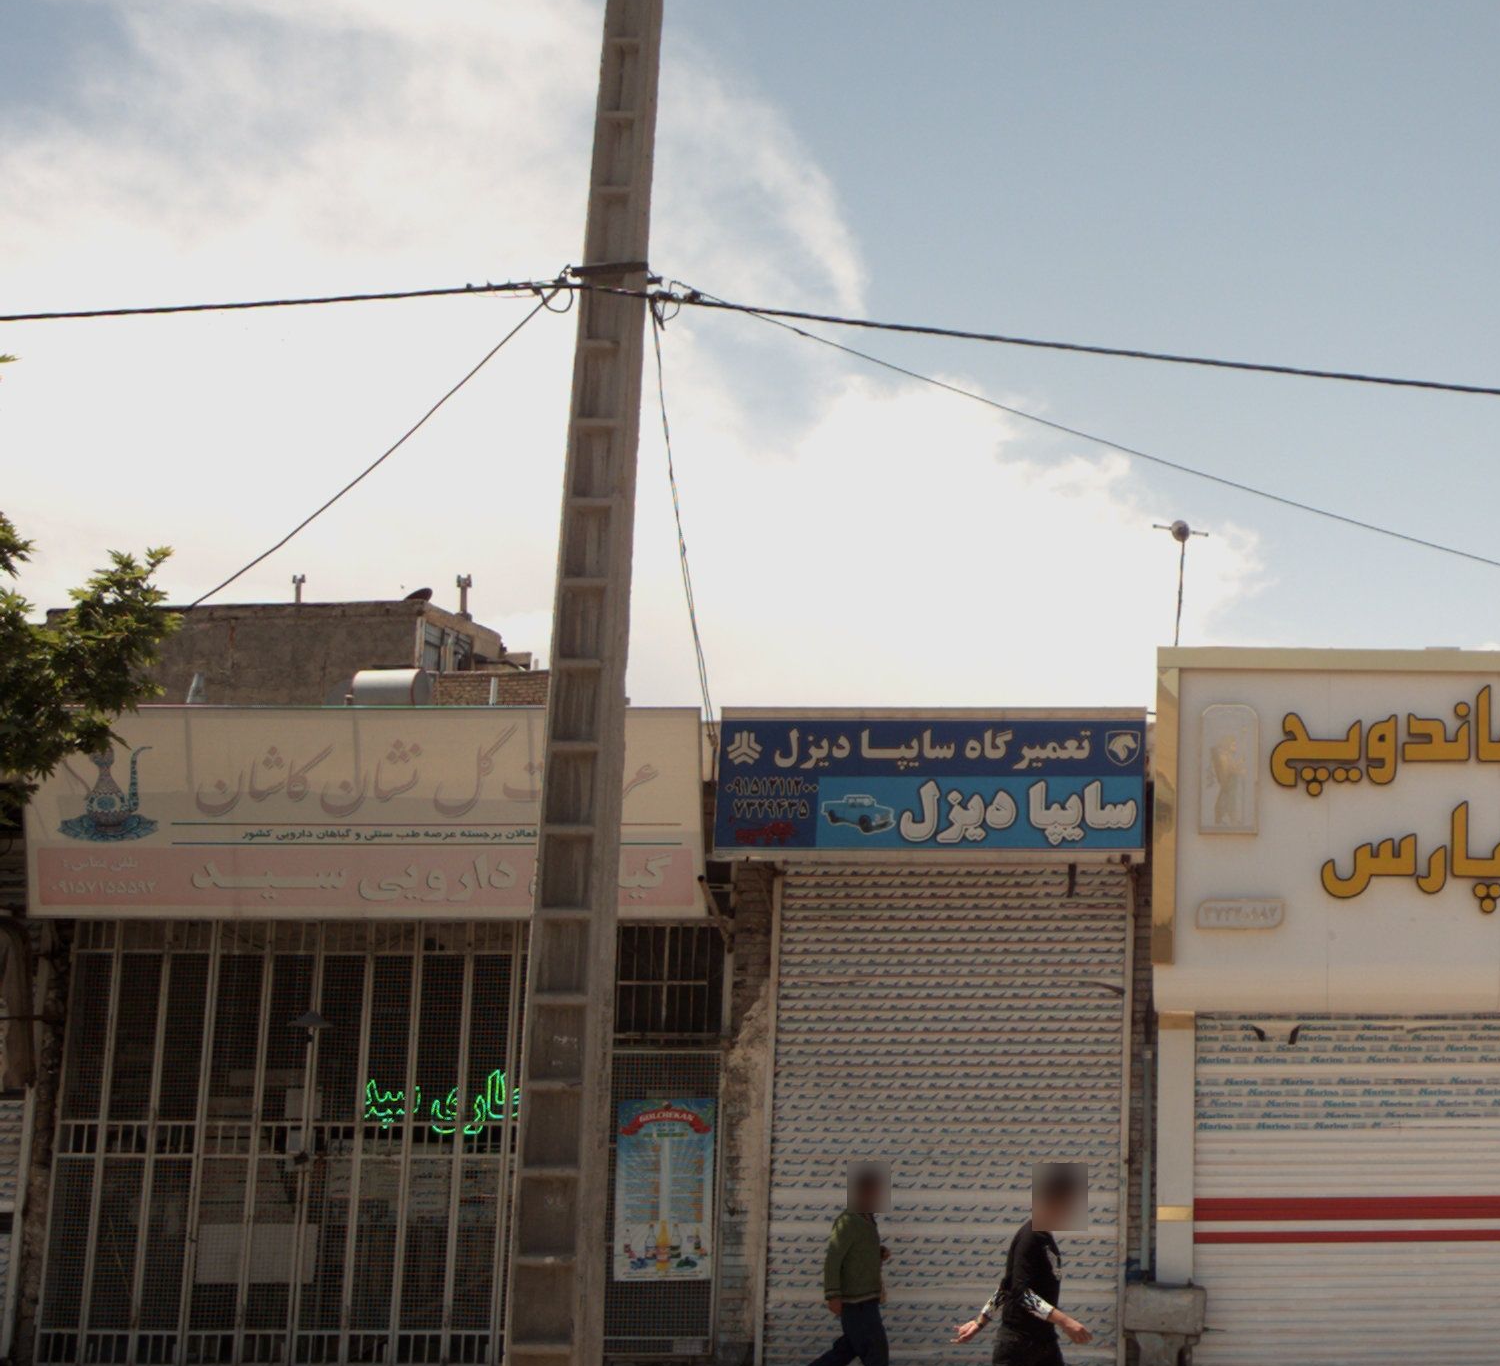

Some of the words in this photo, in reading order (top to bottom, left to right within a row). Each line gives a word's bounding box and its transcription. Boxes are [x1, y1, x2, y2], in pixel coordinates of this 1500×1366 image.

[196, 743, 334, 817] کاشان
[320, 738, 423, 817] نشان
[433, 723, 517, 818] گل
[773, 729, 851, 769] دیزل
[860, 729, 955, 770] سایپا
[242, 829, 271, 841] کشور
[898, 779, 1017, 843] دیزل
[1027, 780, 1138, 847] سایپا
[358, 853, 517, 903] دارویی
